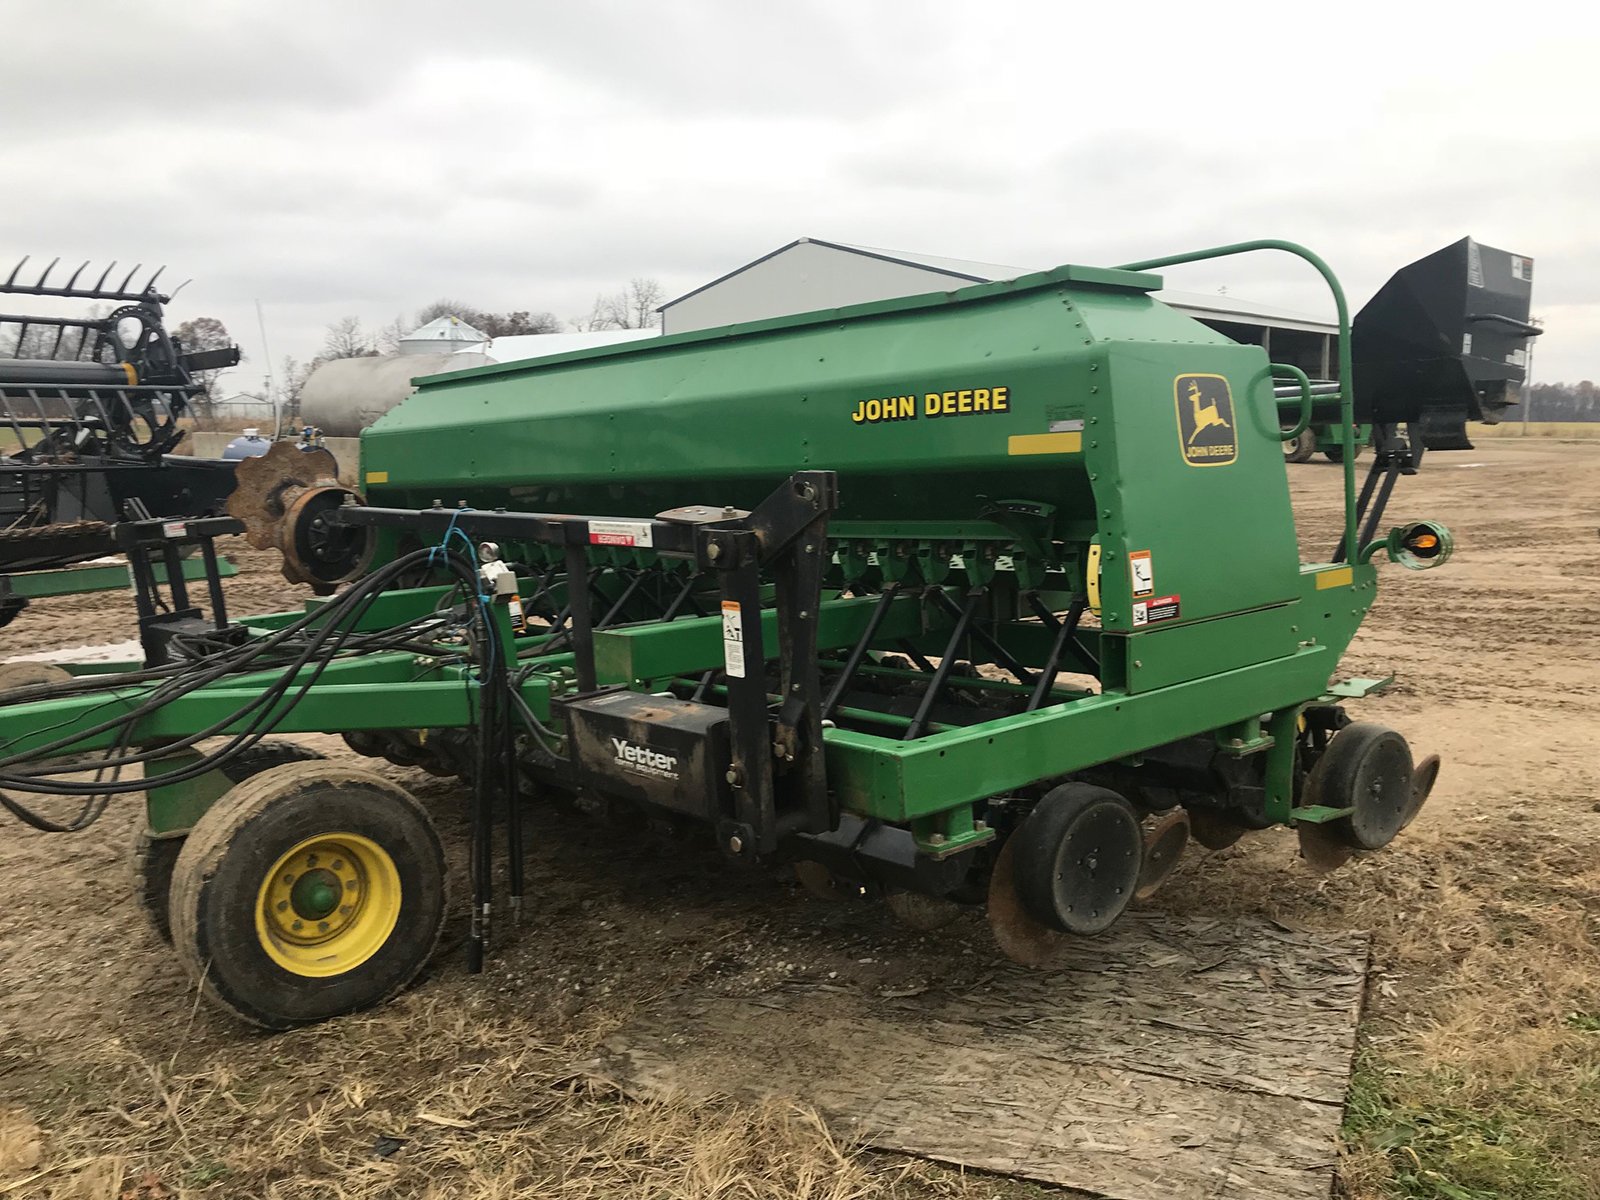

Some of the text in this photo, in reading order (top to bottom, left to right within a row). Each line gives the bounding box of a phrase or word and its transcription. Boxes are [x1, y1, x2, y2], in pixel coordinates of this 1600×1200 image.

[851, 386, 1009, 424] JOHN DEERE
[1187, 444, 1234, 457] JOHN DEERE
[611, 737, 677, 770] Yetter
